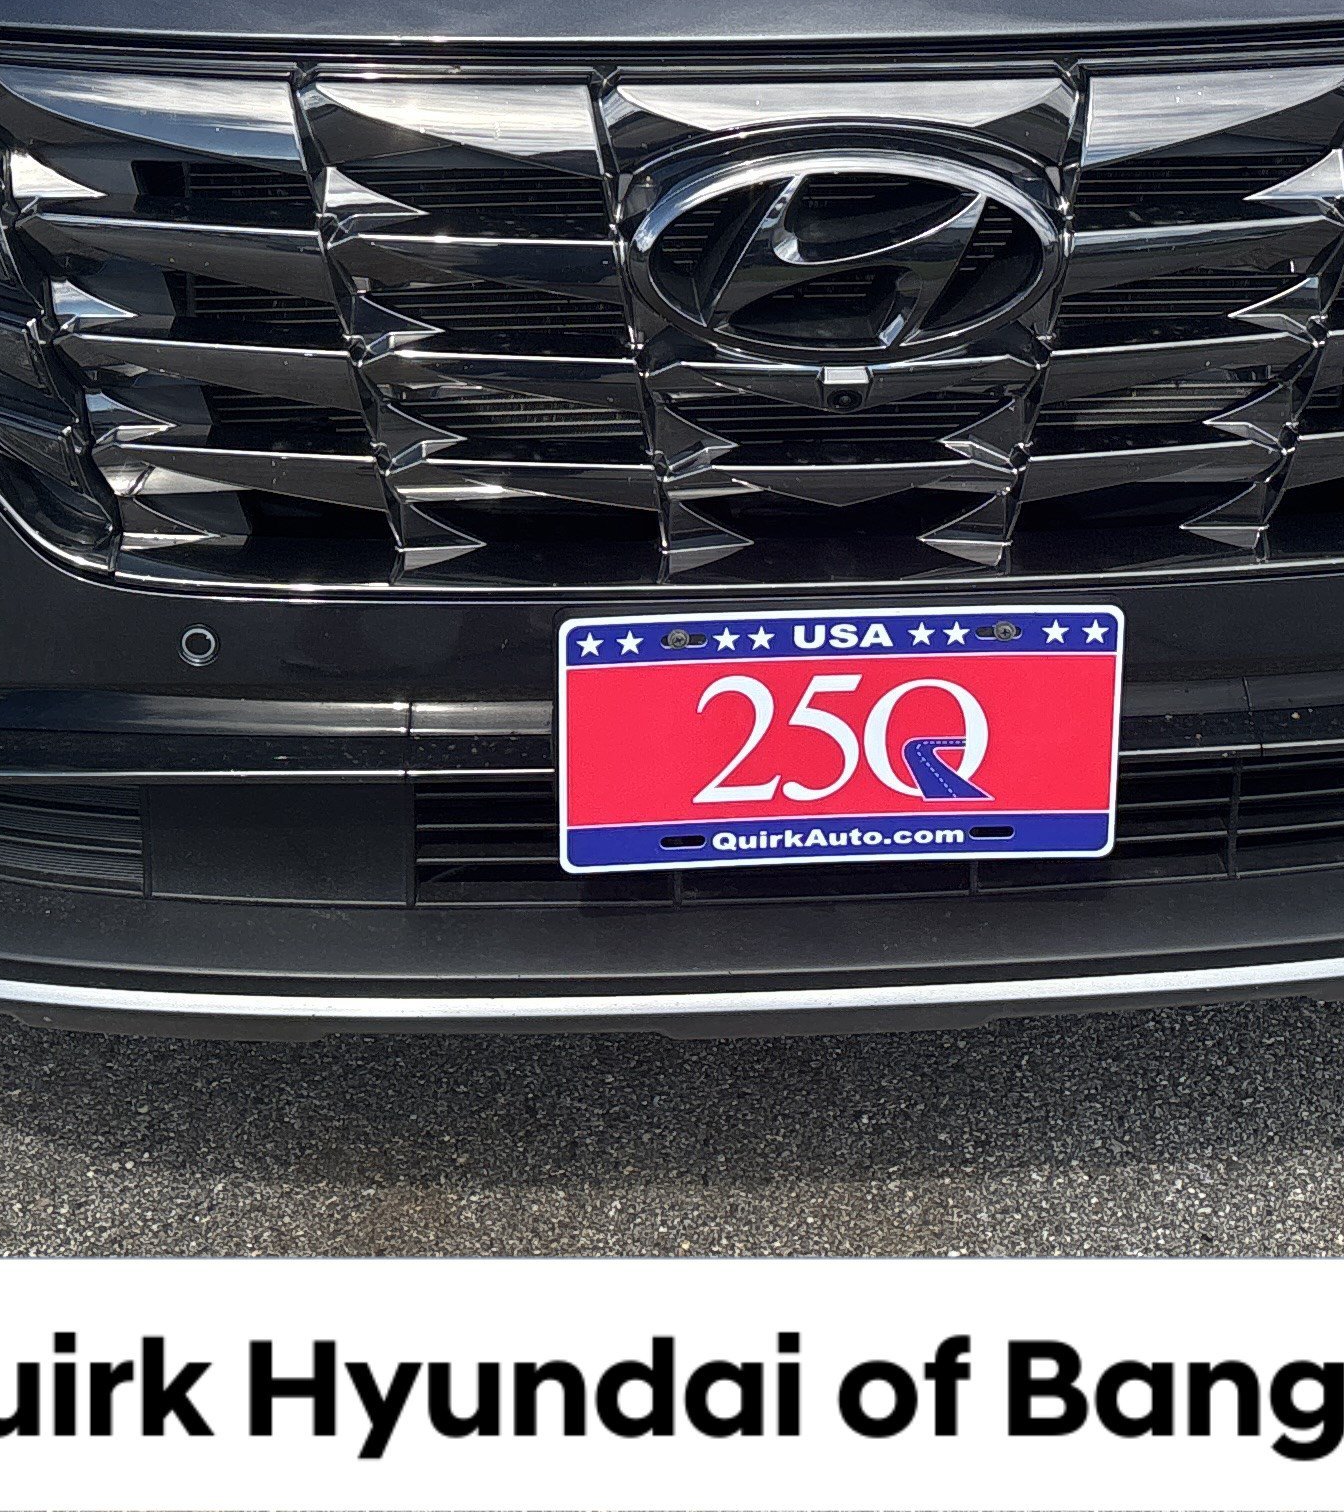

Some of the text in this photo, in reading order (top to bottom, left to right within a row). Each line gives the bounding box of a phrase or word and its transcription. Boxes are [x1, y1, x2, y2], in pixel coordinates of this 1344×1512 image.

[793, 623, 894, 649] USA
[692, 674, 996, 804] 25Q
[711, 825, 965, 852] QuirkAuto.com
